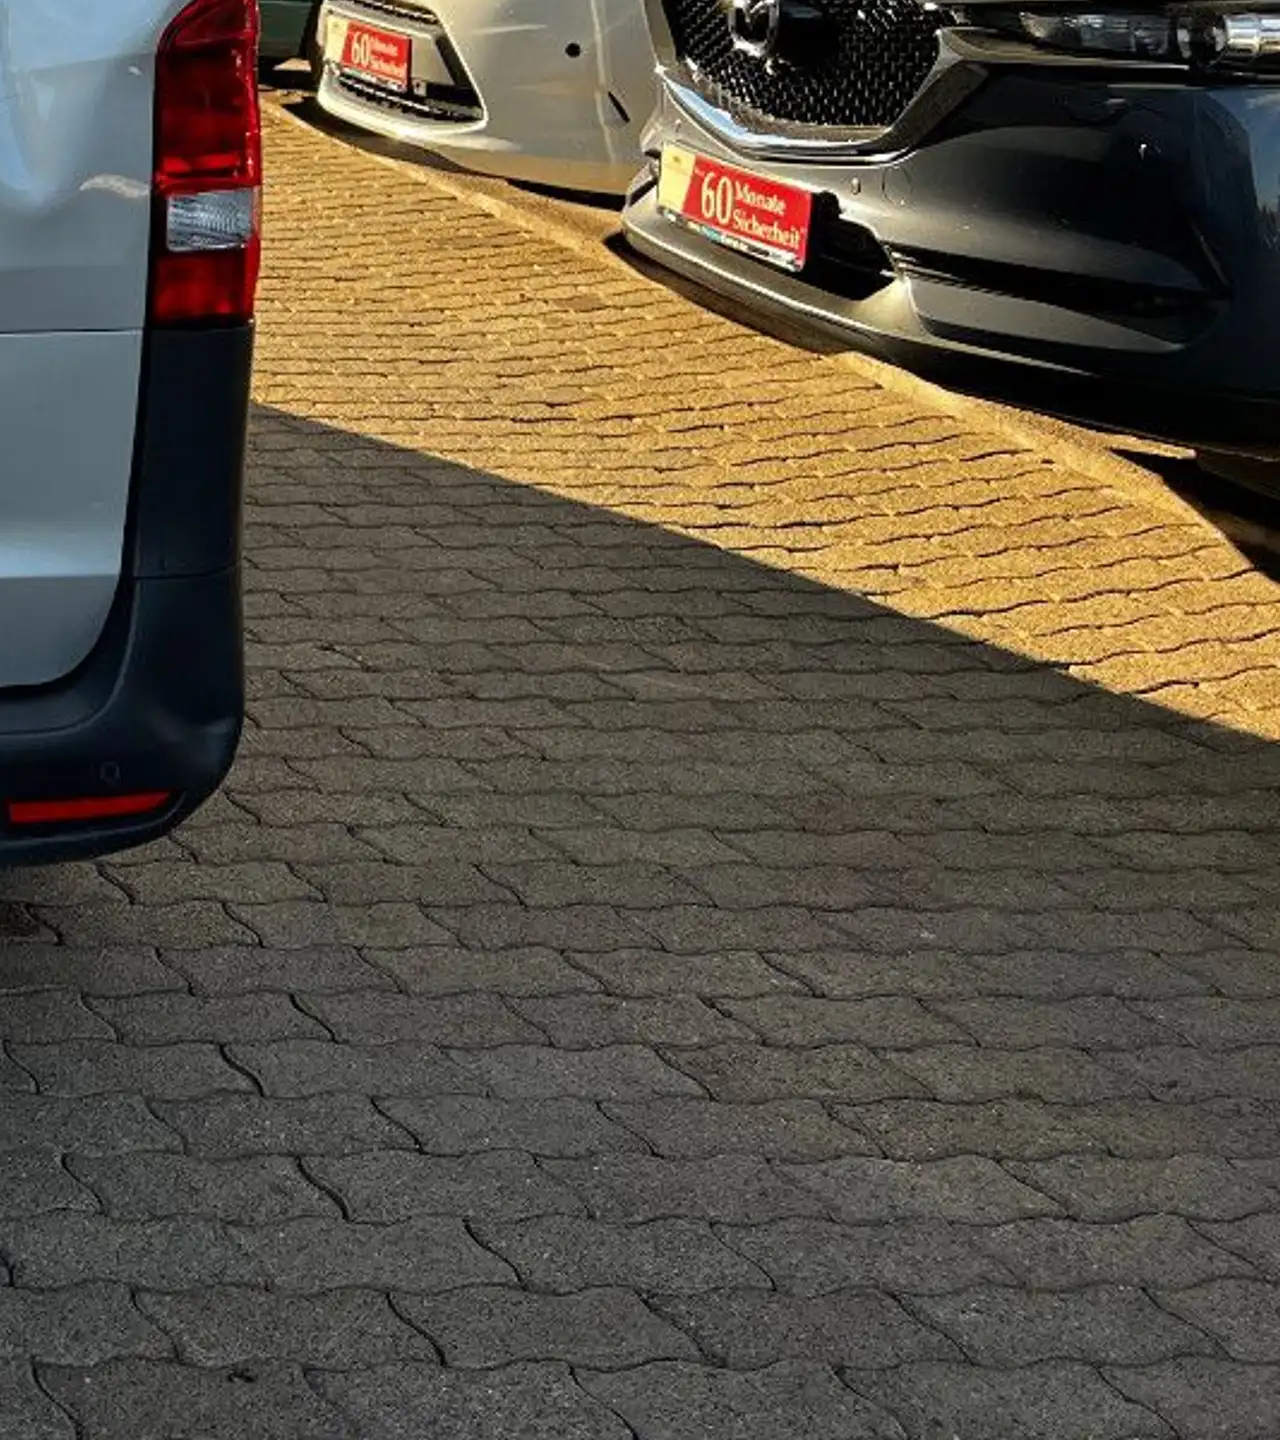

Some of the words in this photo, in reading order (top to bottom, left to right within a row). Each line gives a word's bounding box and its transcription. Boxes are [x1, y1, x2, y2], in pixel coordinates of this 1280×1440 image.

[351, 31, 370, 66] 60
[701, 170, 734, 226] 60
[734, 180, 787, 216] Monate
[732, 209, 801, 250] Sicherheit
